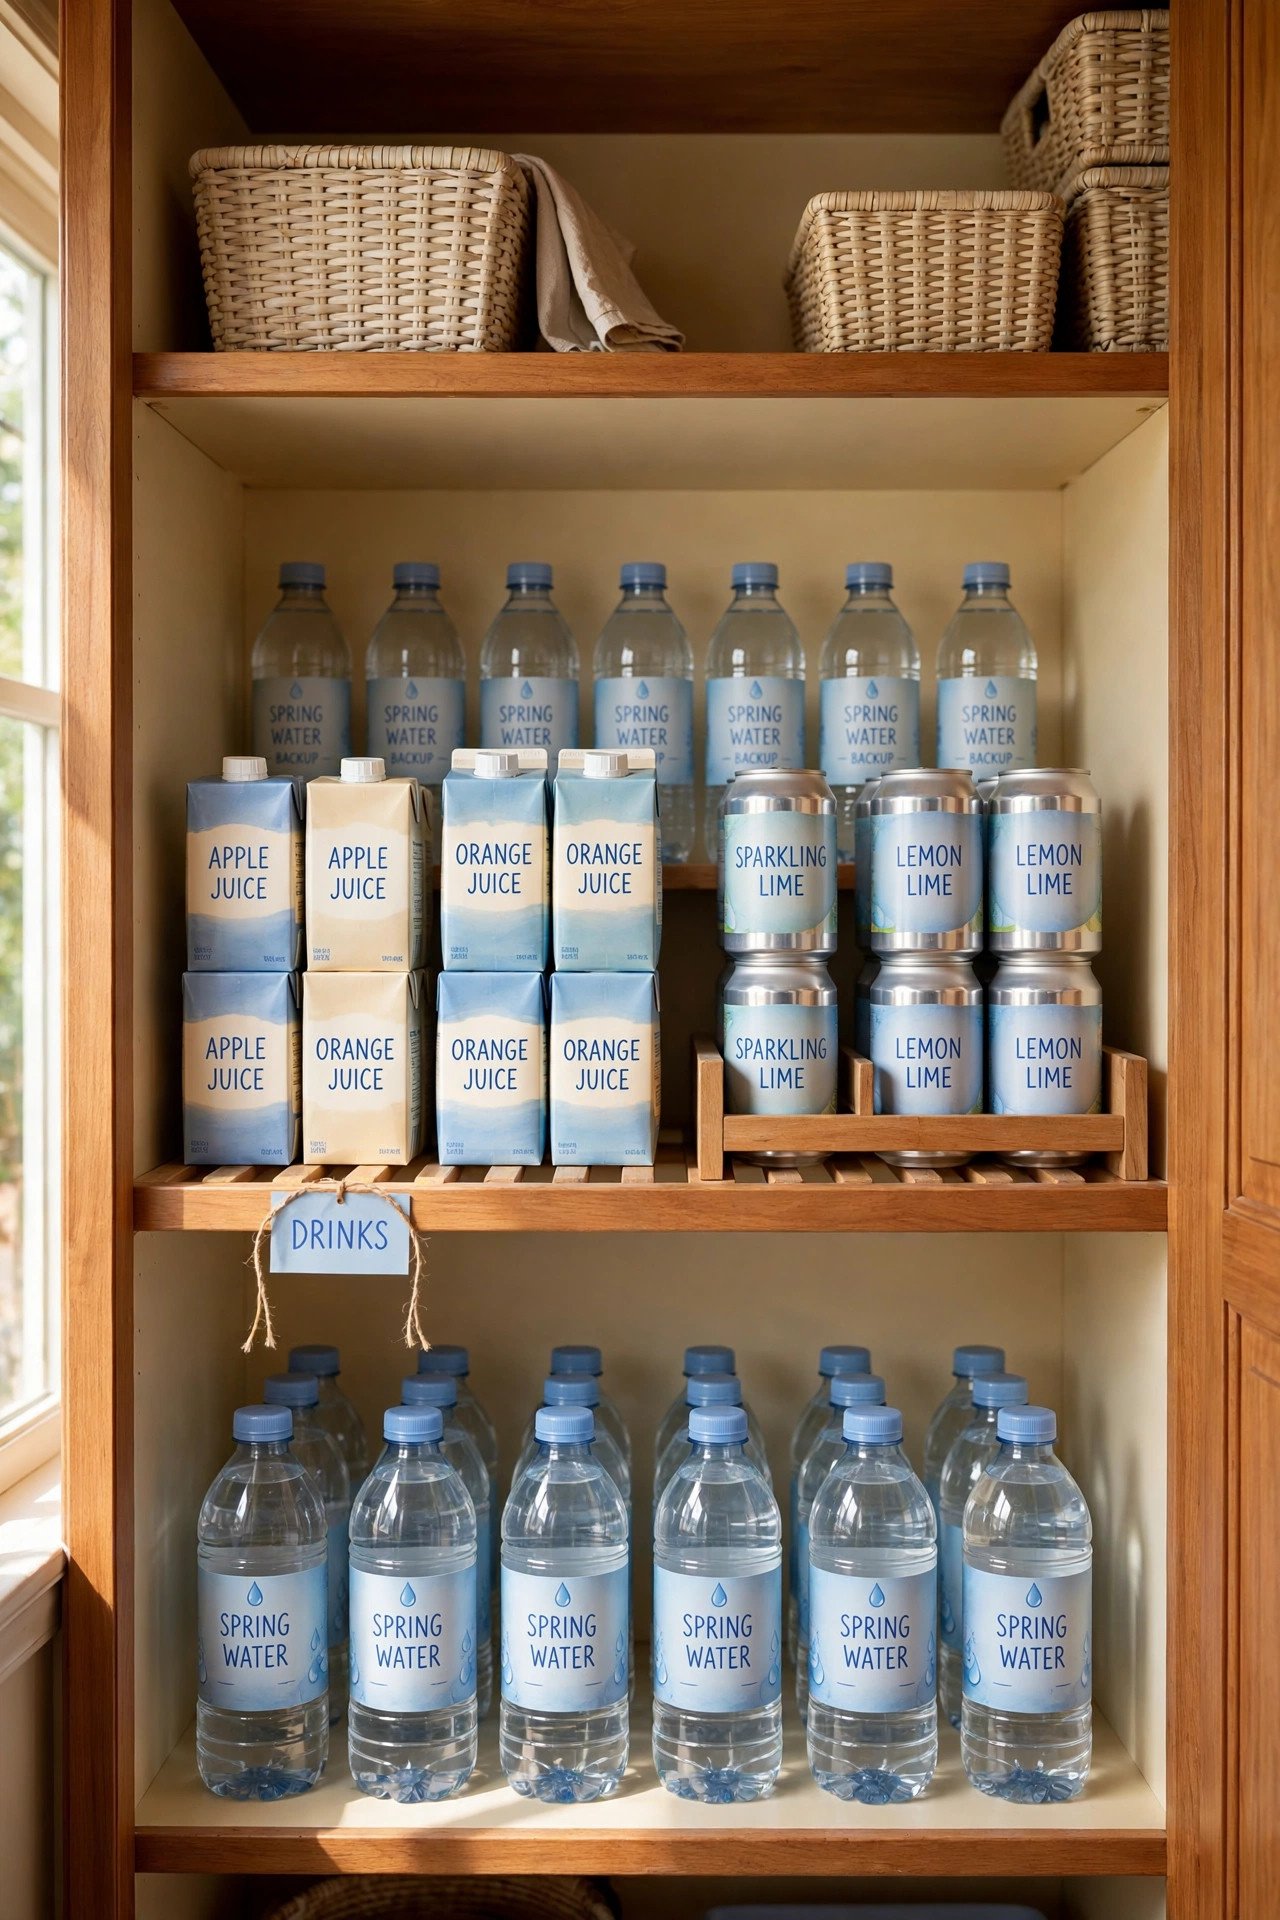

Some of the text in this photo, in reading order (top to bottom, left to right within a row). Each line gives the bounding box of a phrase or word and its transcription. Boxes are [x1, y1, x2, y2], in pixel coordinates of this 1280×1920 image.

[269, 704, 323, 722] SPRING
[384, 704, 438, 722] SPRING
[499, 704, 553, 722] SPRING
[615, 704, 669, 722] SPRING
[727, 704, 782, 722] SPRING
[844, 704, 898, 722] SPRING
[962, 704, 1016, 722] SPRING
[271, 728, 322, 745] WATER
[385, 728, 437, 745] WATER
[500, 728, 552, 745] WATER
[616, 728, 668, 745] WATER
[729, 728, 781, 745] WATER
[846, 728, 897, 745] WATER
[964, 728, 1015, 745] WATER
[275, 752, 319, 765] BACKUP
[391, 752, 434, 765] BACKUP
[734, 752, 778, 765] BACKUP
[850, 752, 894, 765] BACKUP
[969, 752, 1013, 765] BACKUP
[208, 846, 269, 870] APPLE
[328, 846, 388, 870] APPLE
[455, 843, 532, 865] ORANGE
[566, 843, 643, 865] ORANGE
[735, 845, 827, 868] SPARKLING
[896, 845, 962, 868] LEMON
[1016, 844, 1082, 867] LEMON
[210, 877, 267, 900] JUICE
[330, 877, 386, 900] JUICE
[467, 872, 522, 894] JUICE
[578, 872, 632, 894] JUICE
[759, 874, 805, 897] LIME
[907, 874, 953, 897] LIME
[1027, 873, 1073, 896] LIME
[205, 1036, 266, 1060] APPLE
[316, 1037, 395, 1061] ORANGE
[451, 1038, 528, 1061] ORANGE
[563, 1039, 640, 1061] ORANGE
[735, 1037, 827, 1061] SPARKLING
[896, 1037, 962, 1060] LEMON
[1016, 1037, 1082, 1060] LEMON
[207, 1068, 264, 1090] JUICE
[328, 1068, 384, 1090] JUICE
[463, 1068, 518, 1090] JUICE
[575, 1068, 630, 1090] JUICE
[759, 1067, 805, 1090] LIME
[906, 1066, 952, 1089] LIME
[1026, 1066, 1073, 1089] LIME
[292, 1219, 389, 1251] DRINKS
[219, 1612, 291, 1639] SPRING
[372, 1612, 443, 1640] SPRING
[526, 1613, 597, 1640] SPRING
[682, 1613, 754, 1640] SPRING
[840, 1613, 911, 1640] SPRING
[996, 1613, 1068, 1640] SPRING
[222, 1644, 289, 1670] WATER
[375, 1645, 441, 1671] WATER
[530, 1645, 595, 1671] WATER
[685, 1645, 752, 1671] WATER
[843, 1645, 909, 1671] WATER
[999, 1645, 1067, 1671] WATER
